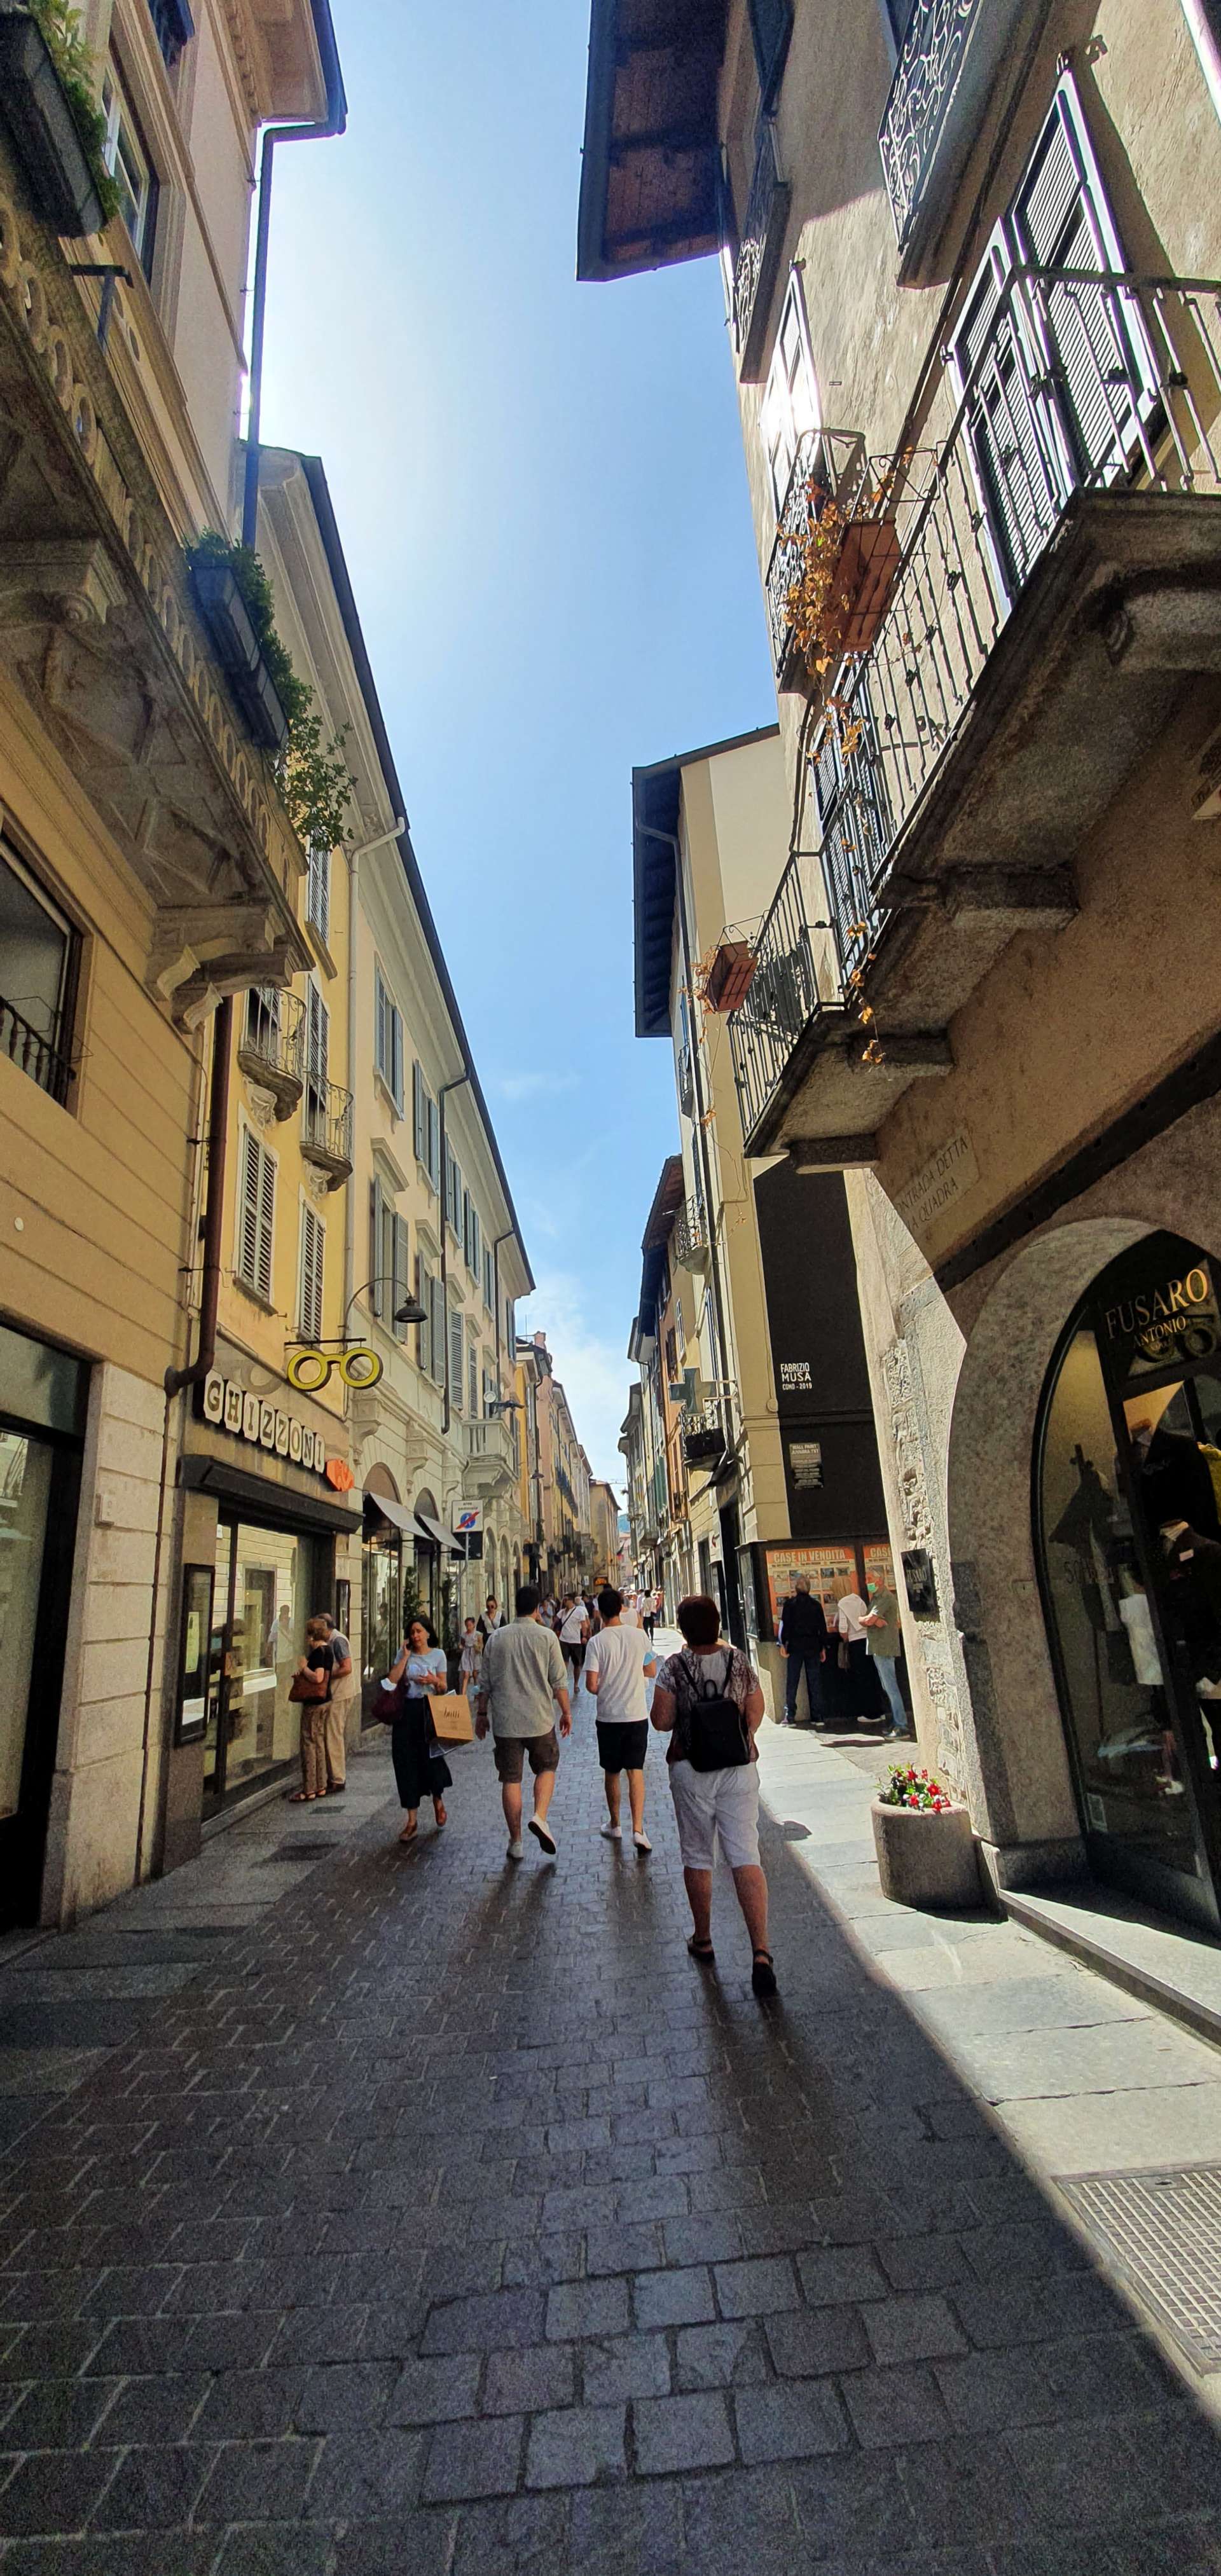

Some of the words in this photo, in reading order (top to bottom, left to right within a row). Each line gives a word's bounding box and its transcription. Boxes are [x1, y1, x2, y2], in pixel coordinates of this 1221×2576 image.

[895, 1170, 935, 1213] ONTRADA
[936, 1136, 968, 1176] DETTA
[920, 1177, 958, 1222] QUADRA
[1105, 1269, 1208, 1339] FUSARO
[1134, 1316, 1186, 1348] ANTONIO
[780, 1362, 810, 1373] FABRIZIO
[782, 1372, 811, 1382] MUSA
[206, 1377, 323, 1467] GHIZZONI
[773, 1552, 796, 1563] CASE
[798, 1552, 807, 1562] IN
[808, 1549, 846, 1561] VENDITA
